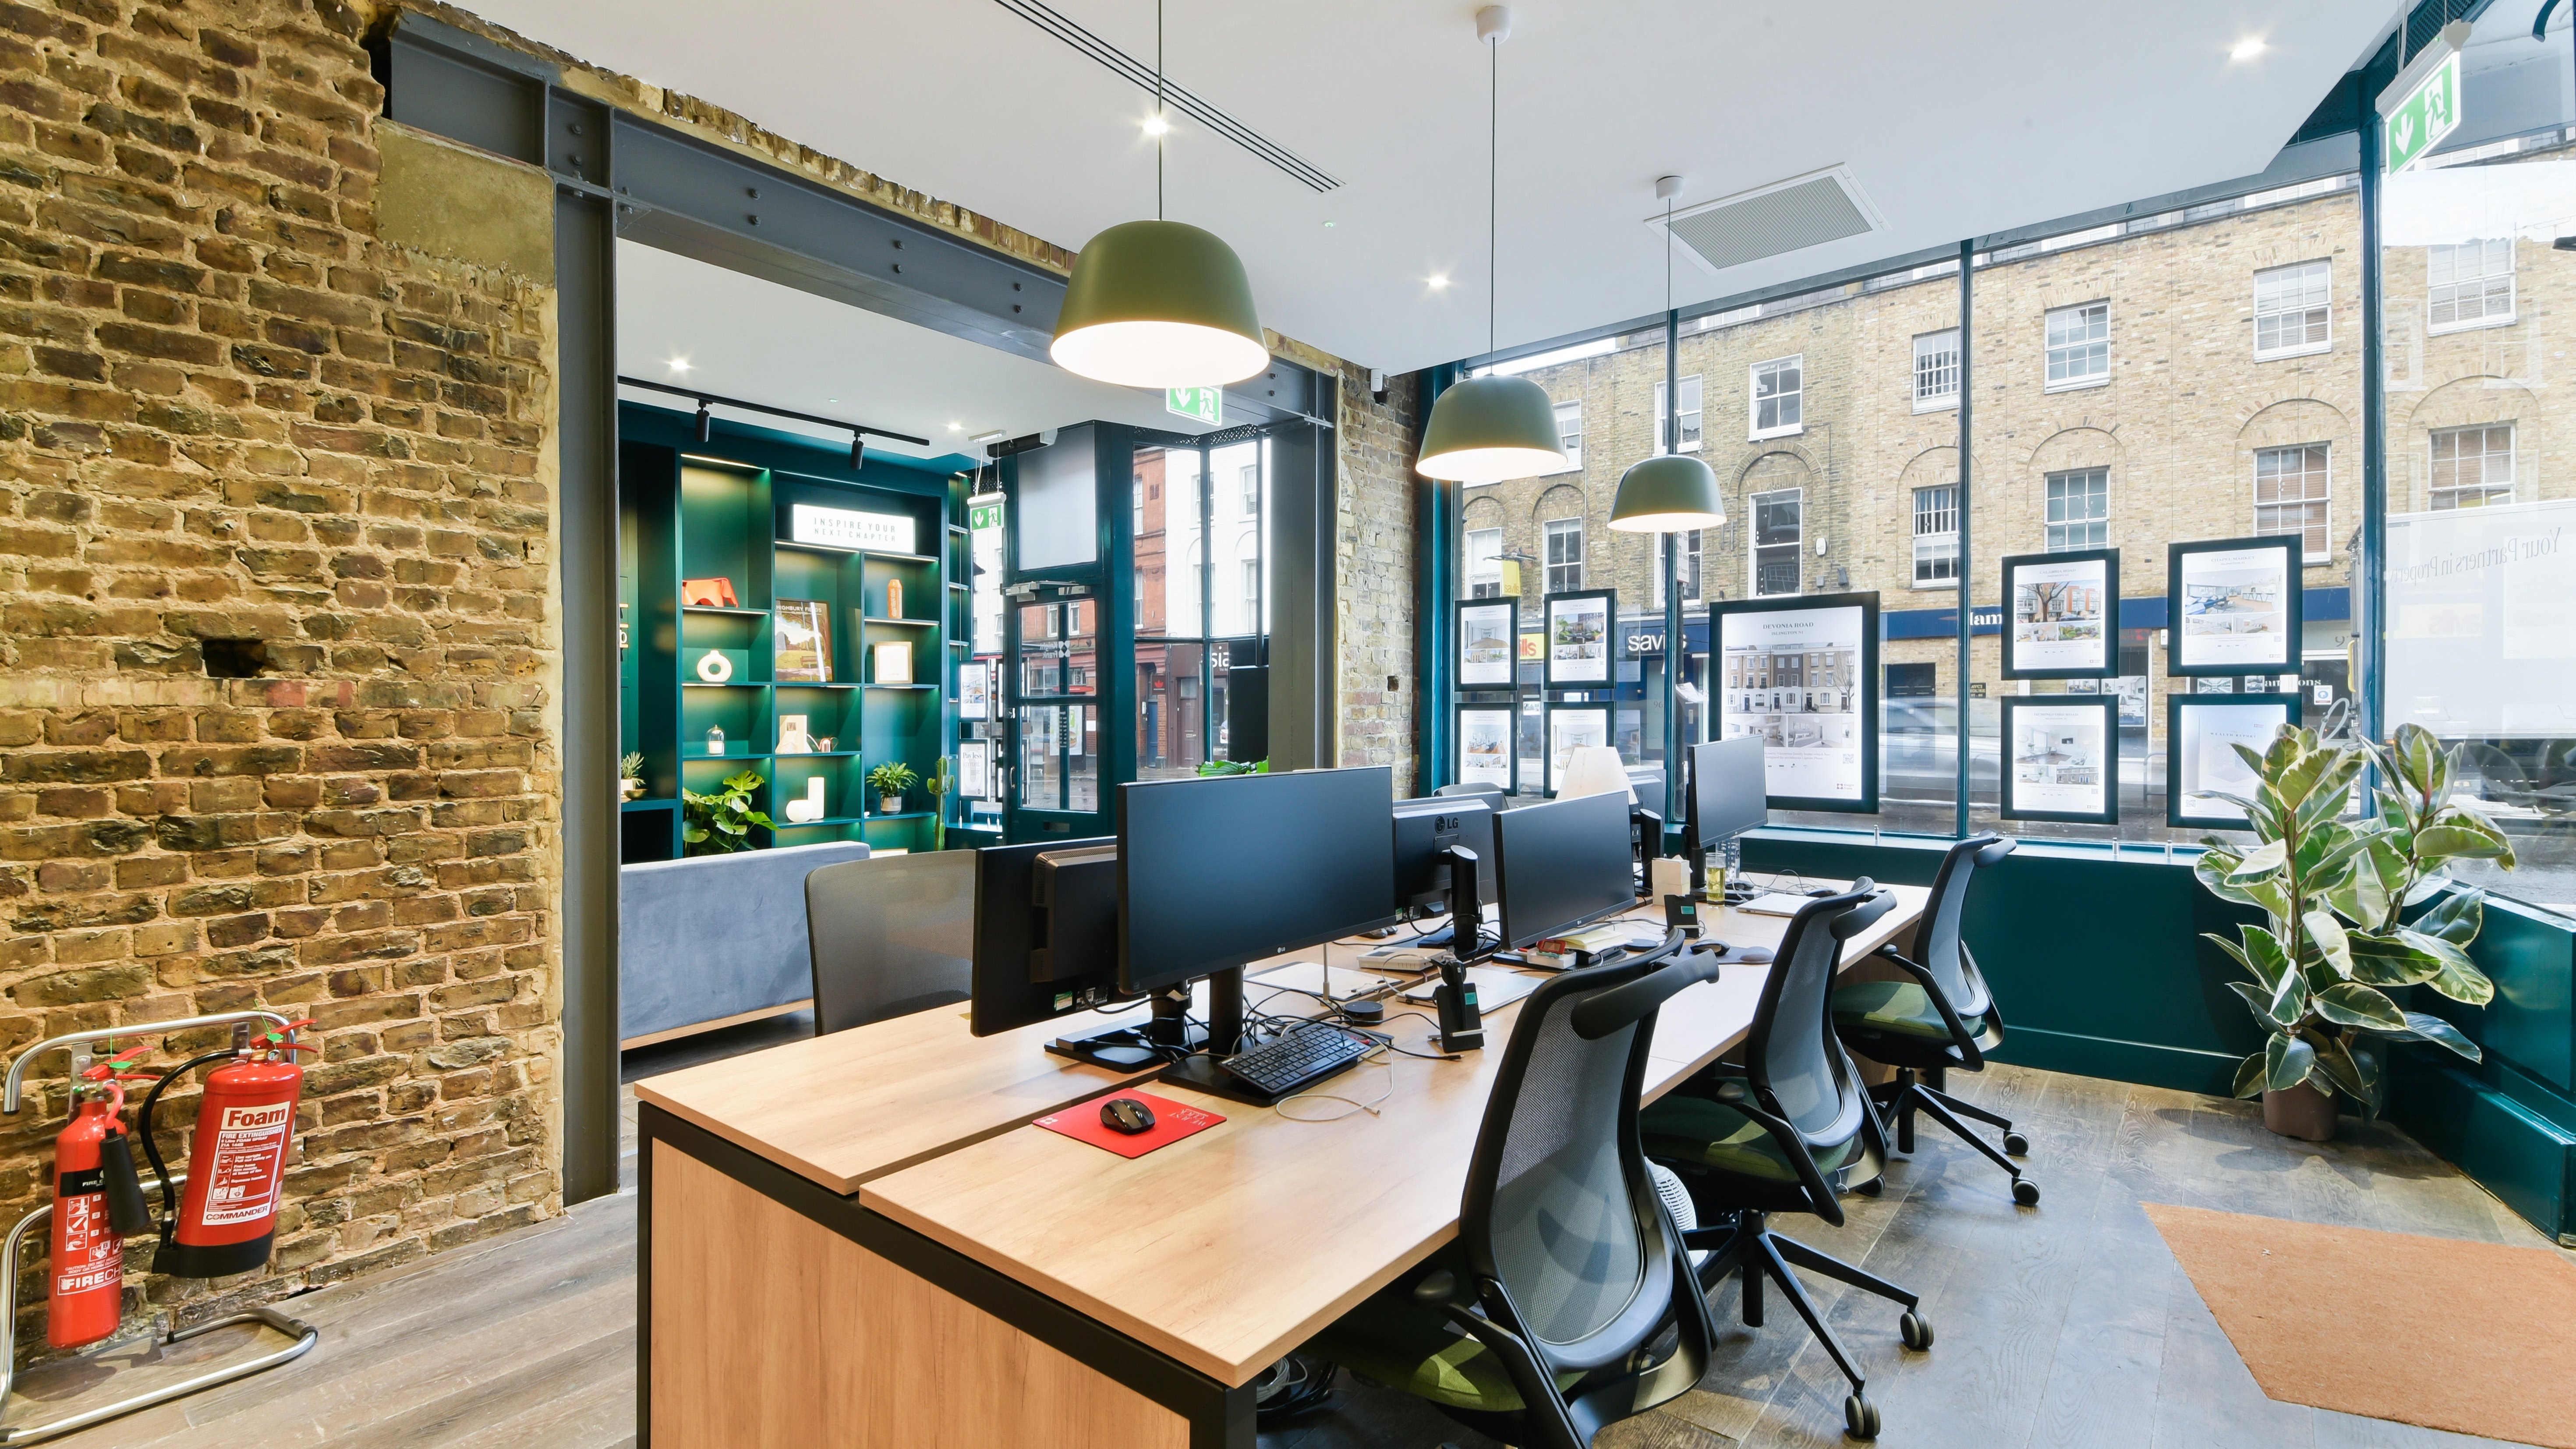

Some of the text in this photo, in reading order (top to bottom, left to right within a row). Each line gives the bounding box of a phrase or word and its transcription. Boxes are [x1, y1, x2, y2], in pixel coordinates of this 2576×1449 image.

[814, 517, 895, 533] INSPIRE YOUR
[814, 528, 895, 542] NEXT CHAPTER
[1504, 584, 1519, 594] savills
[1447, 817, 1458, 829] LG
[227, 1108, 286, 1127] Foam
[238, 1127, 283, 1139] EXTINGUISHER
[206, 1205, 268, 1220] COMMANDER
